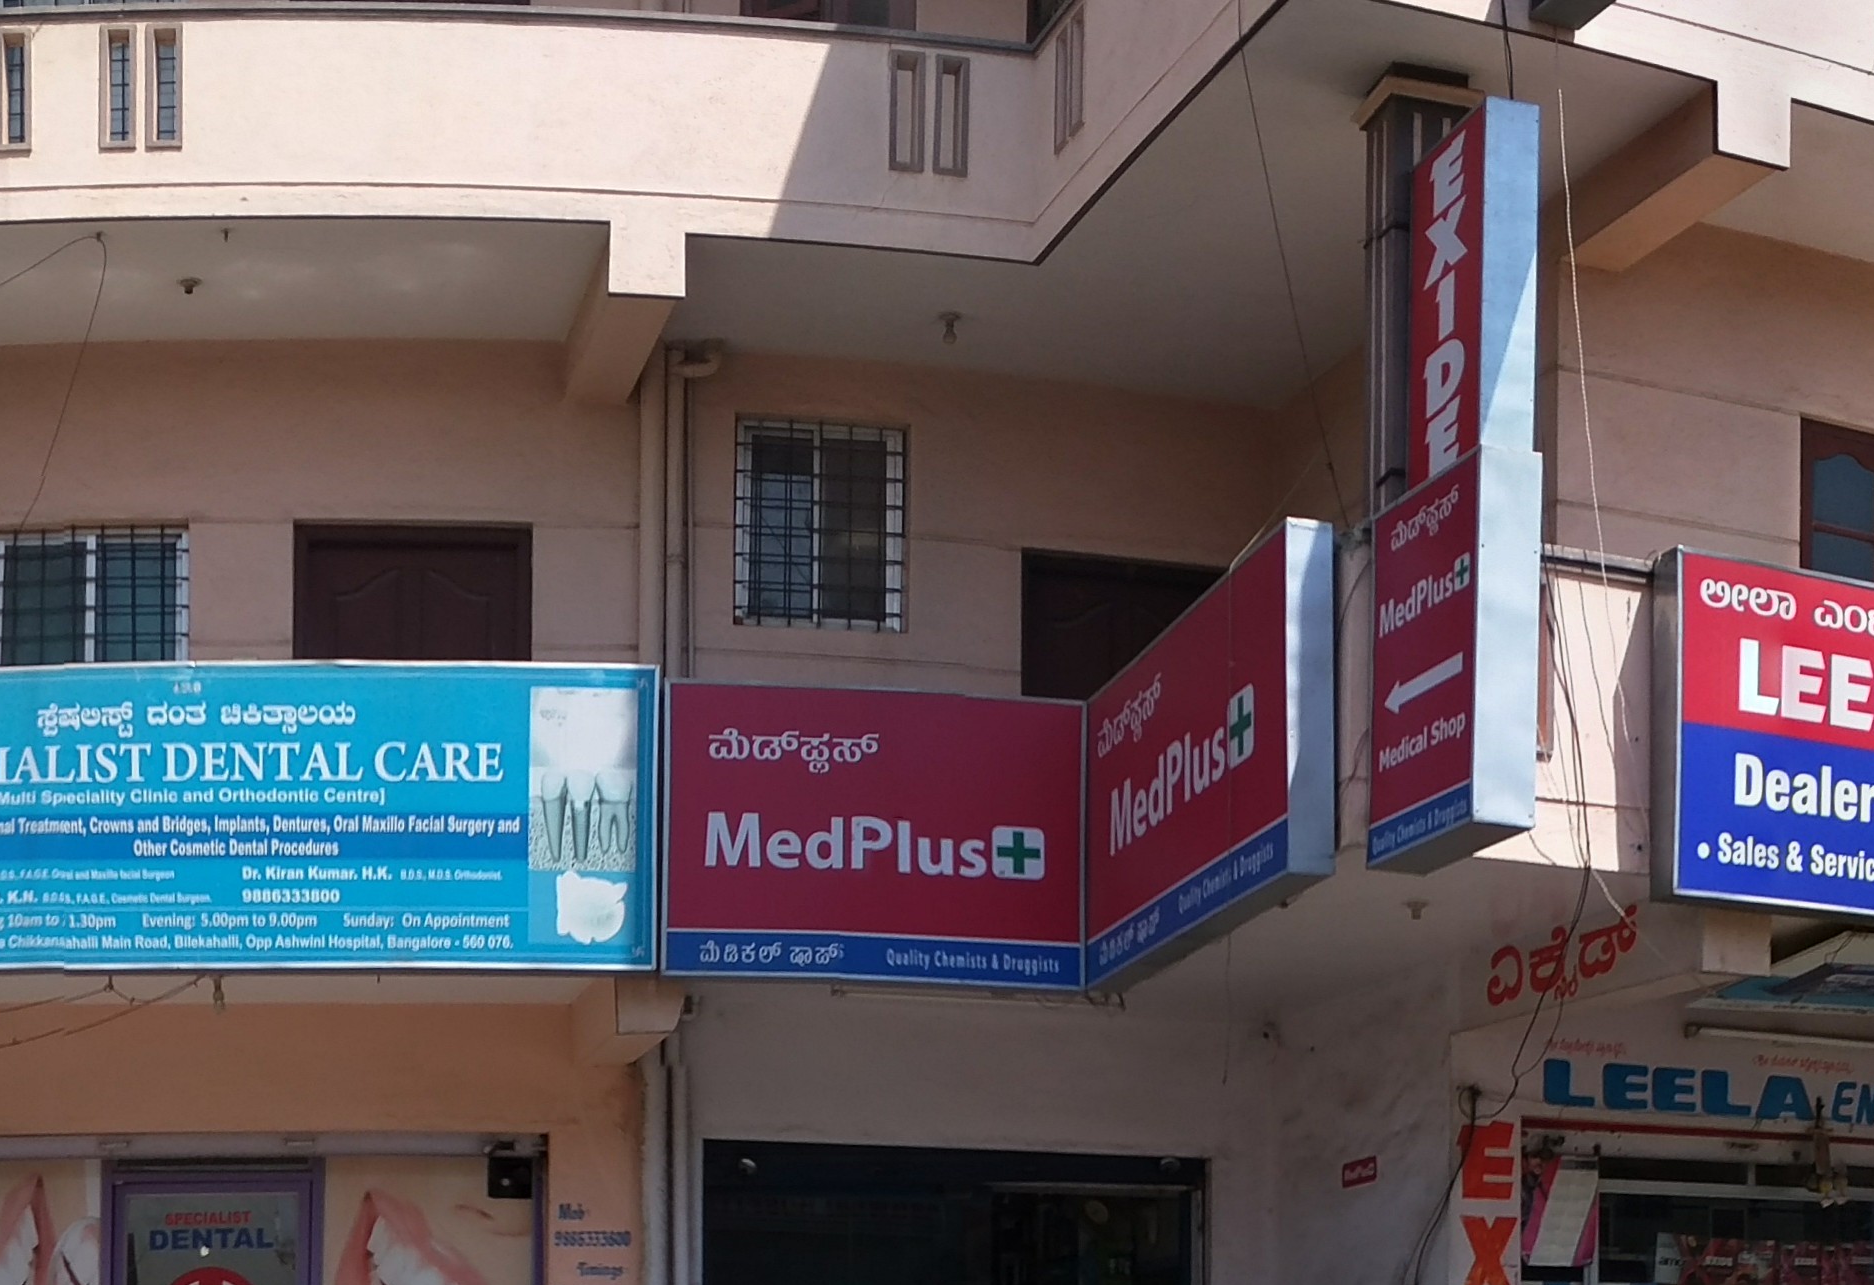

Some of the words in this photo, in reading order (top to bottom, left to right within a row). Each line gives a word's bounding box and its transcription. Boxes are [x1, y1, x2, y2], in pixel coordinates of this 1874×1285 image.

[1422, 128, 1469, 478] EXIDE
[1379, 569, 1453, 638] MedPlus
[1699, 577, 1798, 621] ಲೀಲಾ
[1379, 726, 1428, 772] Medical
[1431, 711, 1466, 748] Shop
[161, 741, 365, 784] DENTAL
[373, 741, 504, 783] CARE
[130, 788, 177, 804] Clinic
[183, 788, 214, 804] and
[218, 787, 320, 804] Orthodontic
[1109, 725, 1226, 857] MedPlus
[89, 815, 135, 835] Crowns
[137, 815, 160, 834] and
[162, 814, 212, 836] Bridges,
[214, 814, 270, 837] Implants,
[272, 815, 331, 836] Dentures,
[333, 815, 359, 833] Oral
[361, 815, 405, 834] Maxillo
[407, 815, 444, 834] Facial
[447, 815, 495, 837] Surgery
[497, 816, 520, 834] and
[133, 839, 168, 857] Other
[170, 839, 227, 857] Cosmetic
[228, 838, 268, 857] Dental
[271, 839, 340, 858] Procedures
[704, 810, 988, 880] MedPlus
[1717, 831, 1781, 870] Sales
[1785, 840, 1804, 873] &
[242, 866, 262, 881] Dr.
[265, 866, 303, 881] Kiran
[1178, 884, 1202, 915] Quality
[1239, 841, 1275, 878] Druggists
[241, 888, 341, 904] 9886333800
[68, 913, 117, 931] 1.30pm
[201, 912, 249, 930] 5.00pm
[252, 912, 266, 927] to
[269, 912, 318, 930] 9.00pm
[402, 912, 421, 928] On
[424, 912, 510, 931] Appointment
[102, 935, 131, 950] Main
[246, 935, 272, 951] Opp
[275, 935, 325, 949] Ashwini
[387, 935, 451, 951] Bangalore
[885, 947, 931, 972] Quality
[934, 950, 988, 972] Chemists
[991, 953, 1000, 971] &
[1003, 953, 1061, 976] Druggists
[1542, 1057, 1814, 1121] LEELA
[164, 1210, 252, 1227] SPECIALIST
[149, 1227, 275, 1251] DENTAL
